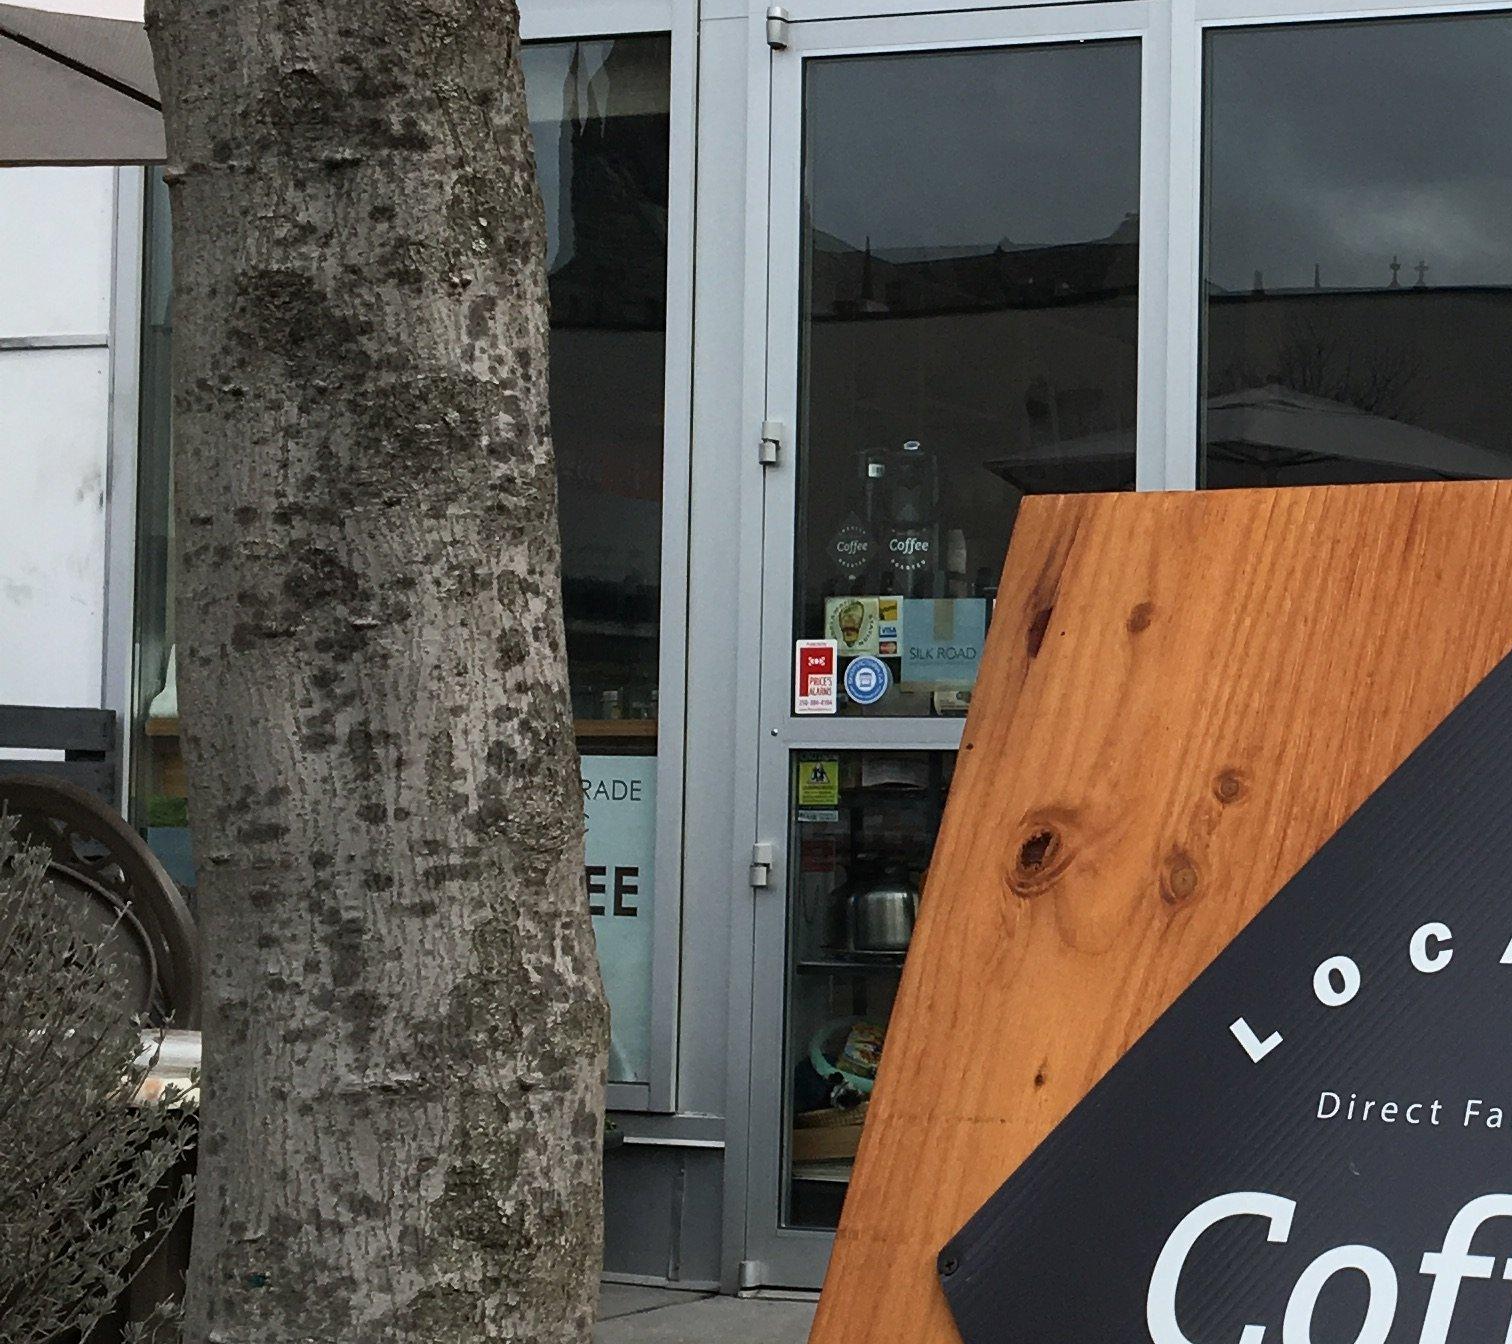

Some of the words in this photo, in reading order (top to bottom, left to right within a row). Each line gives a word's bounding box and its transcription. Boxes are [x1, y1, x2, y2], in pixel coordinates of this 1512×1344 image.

[836, 539, 868, 555] Coffee
[889, 537, 929, 555] Coffee
[909, 646, 934, 660] SILK
[936, 646, 977, 660] ROAD
[1316, 1091, 1443, 1125] Direct
